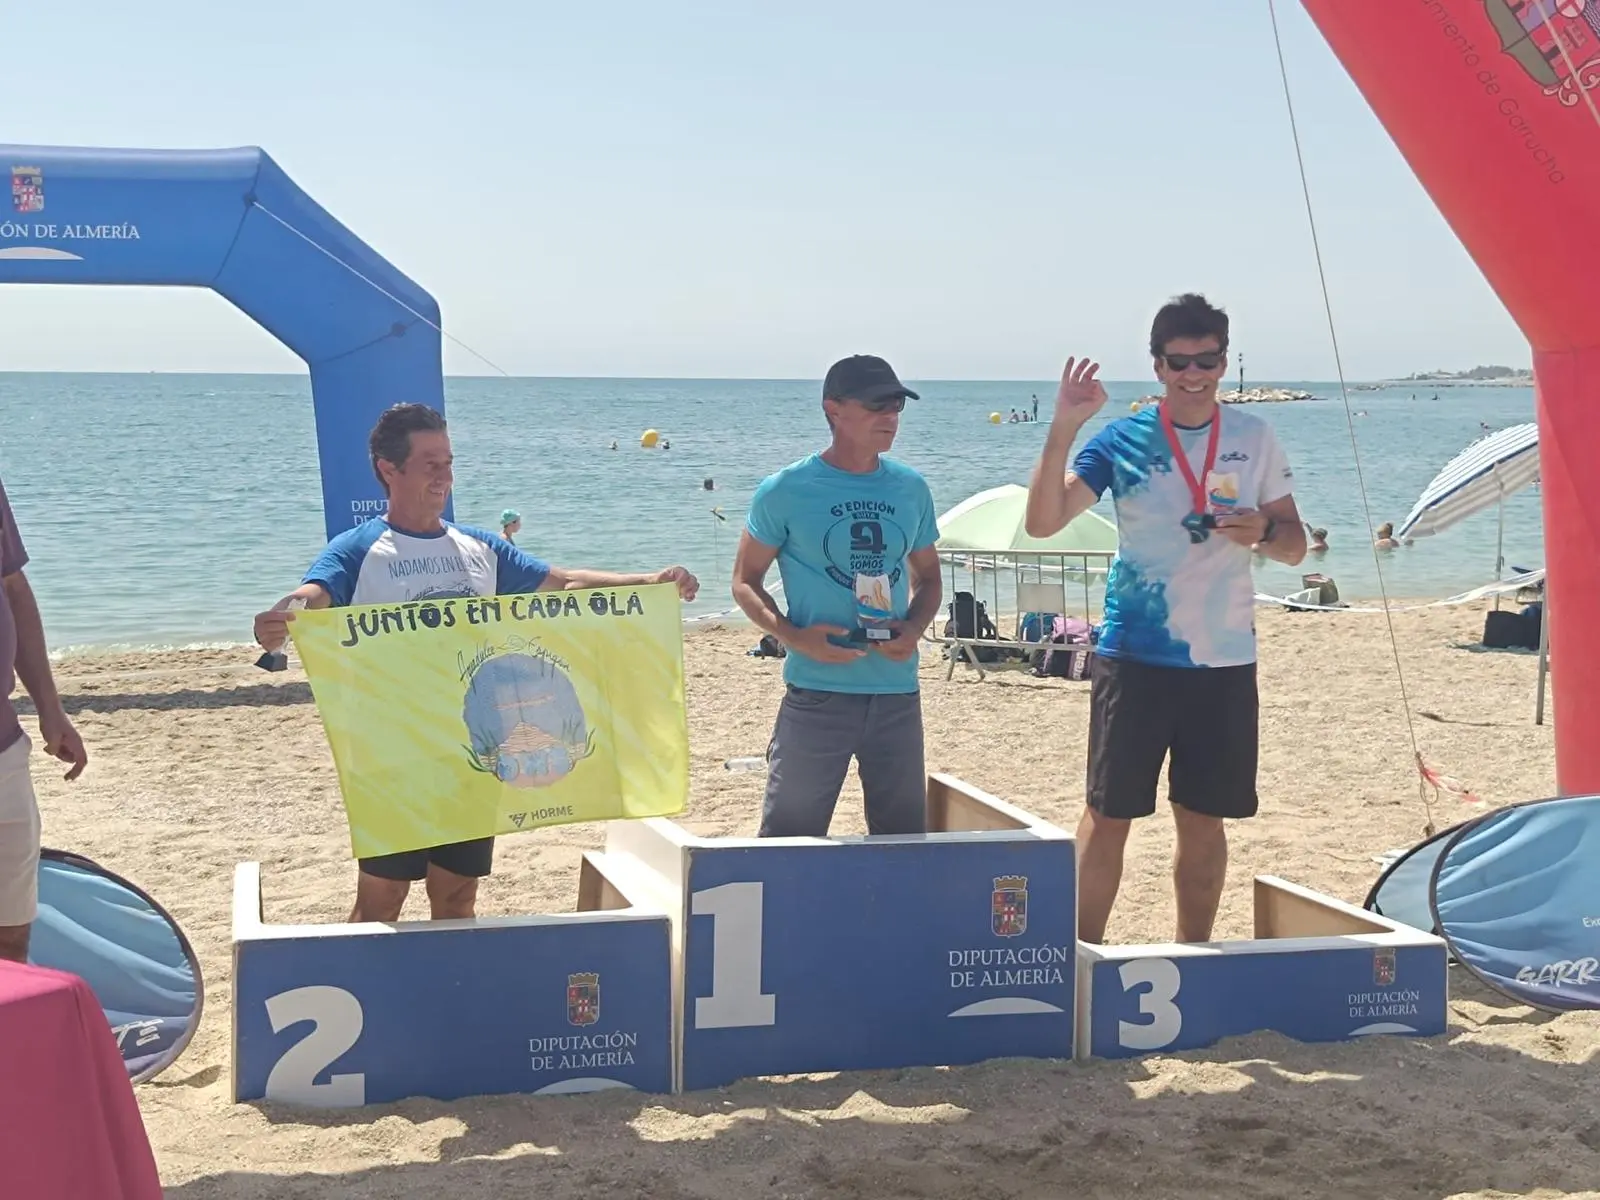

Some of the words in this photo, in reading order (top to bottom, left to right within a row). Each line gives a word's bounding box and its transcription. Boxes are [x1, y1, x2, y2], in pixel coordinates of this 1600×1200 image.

[1477, 69, 1500, 96] de
[1499, 98, 1565, 185] Garrucha
[34, 223, 58, 239] DE
[62, 221, 140, 239] ALMERÍA
[844, 500, 895, 516] EDICIÓN
[388, 556, 440, 579] NADAMOS
[440, 555, 455, 574] EN
[850, 559, 884, 570] SOMOS
[465, 597, 501, 625] EN
[511, 592, 582, 621] CADA
[587, 591, 644, 616] OLA
[531, 805, 574, 822] HORME
[691, 881, 776, 1030] 1
[948, 943, 1068, 968] DIPUTACIÓN
[950, 970, 975, 989] DE
[979, 964, 1064, 987] ALMERÍA
[1118, 958, 1182, 1050] 3
[1347, 987, 1420, 1005] DIPUTACIÓN
[1348, 1005, 1365, 1019] DE
[1366, 1001, 1418, 1017] ALMERÍA
[264, 985, 365, 1107] 2
[528, 1029, 638, 1054] DIPUTACIÓN
[530, 1054, 555, 1071] DE
[558, 1048, 635, 1070] ALMERÍA
